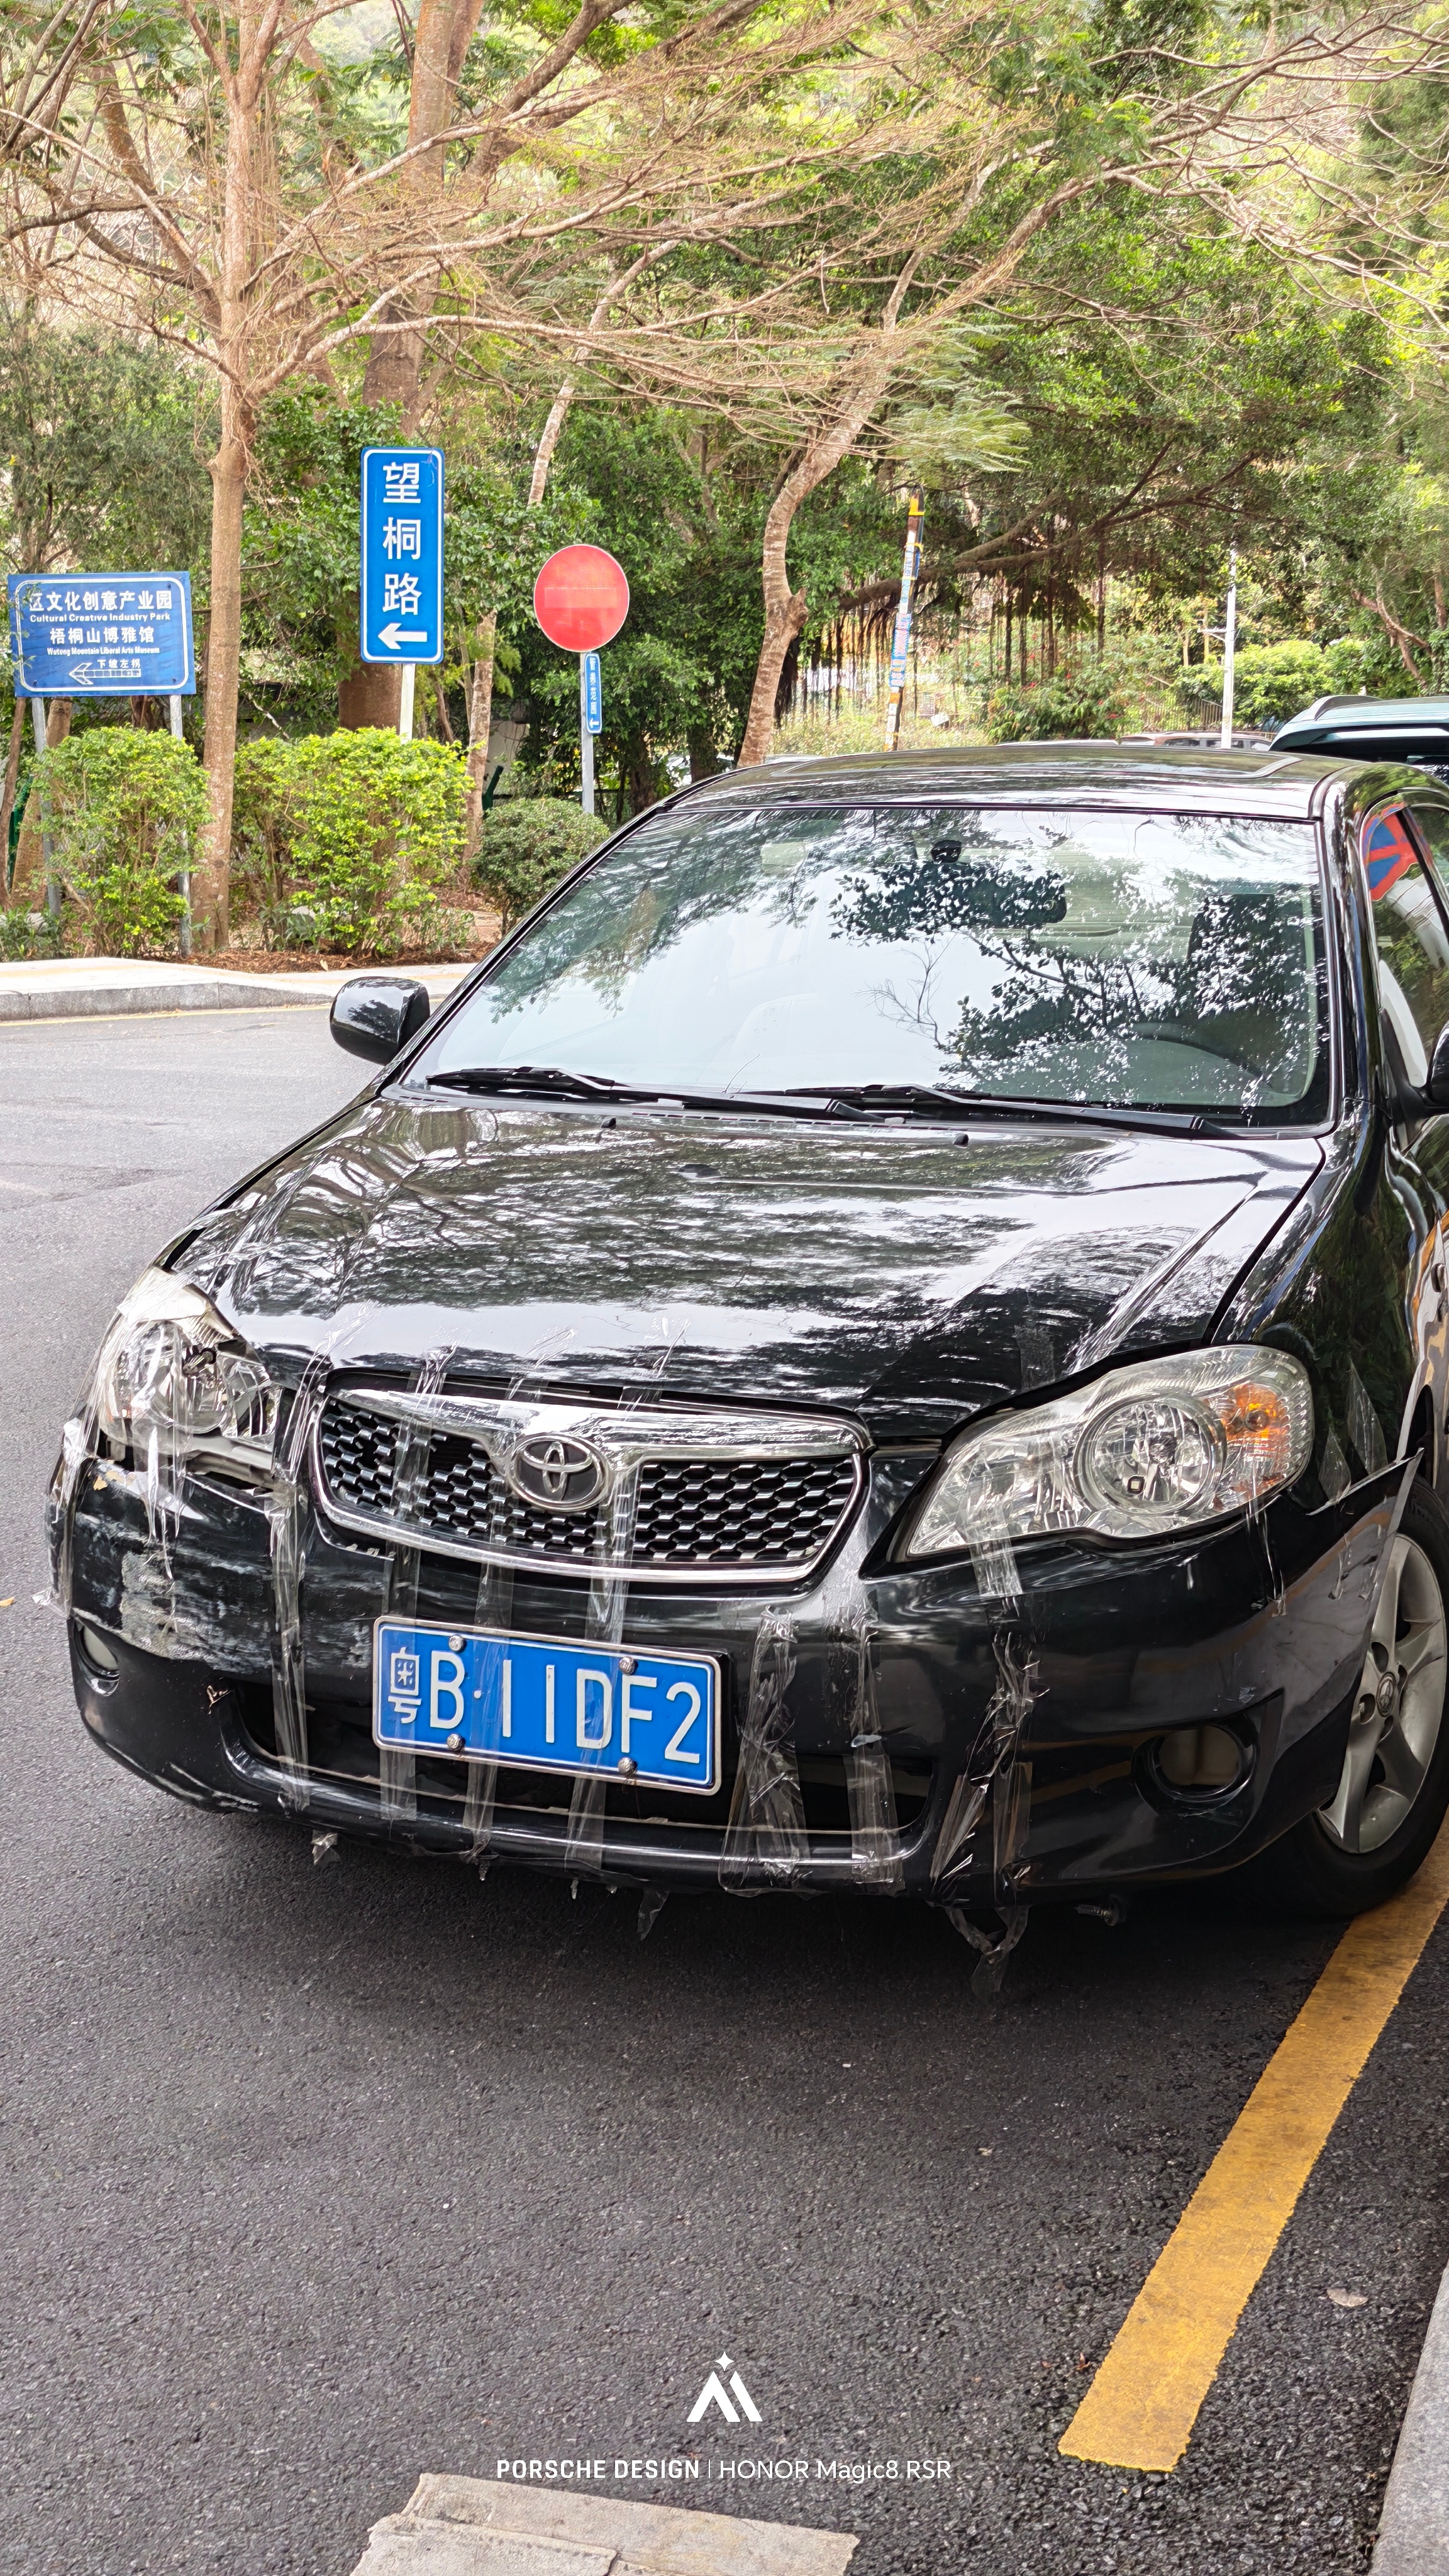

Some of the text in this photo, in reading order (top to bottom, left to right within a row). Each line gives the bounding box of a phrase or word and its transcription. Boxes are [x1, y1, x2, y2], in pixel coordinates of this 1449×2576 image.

[382, 462, 421, 616] 望桐路
[30, 613, 170, 623] Cultural Creative Industry Park
[50, 626, 154, 645] 梧桐山博雅馆
[47, 648, 70, 657] Wutong
[100, 647, 120, 655] Liberal
